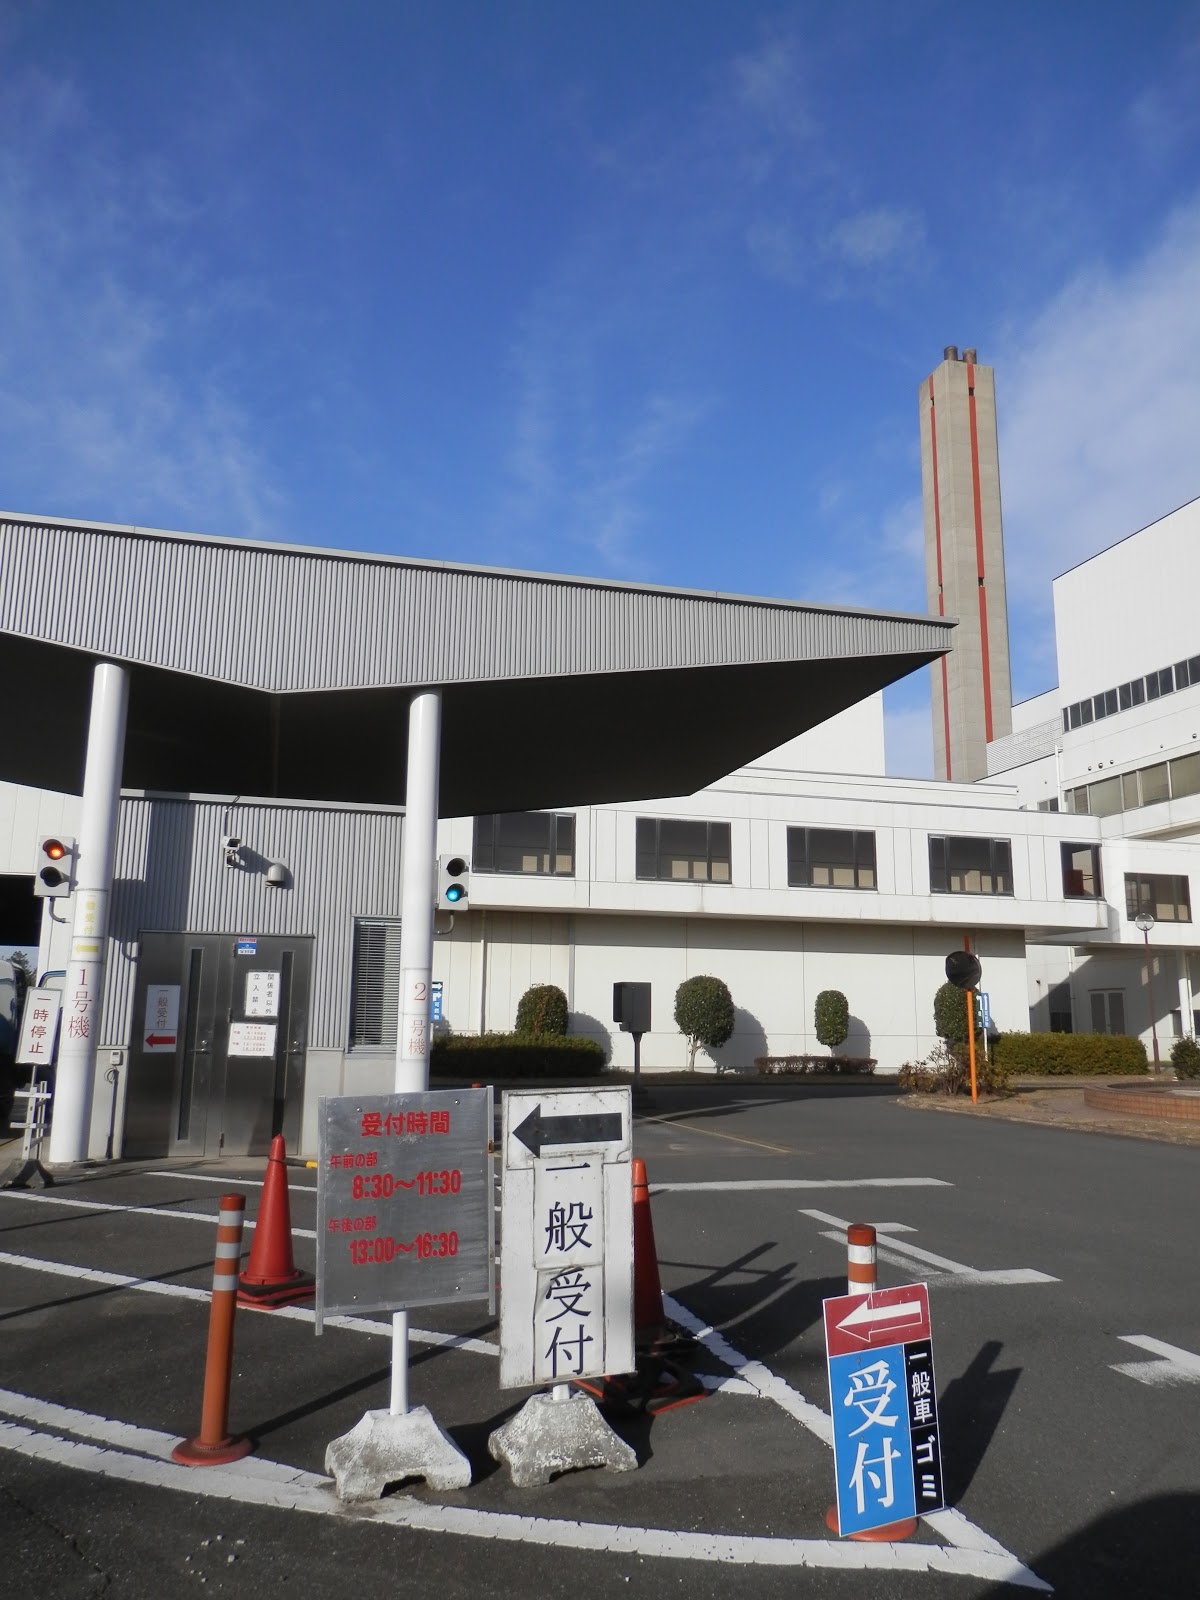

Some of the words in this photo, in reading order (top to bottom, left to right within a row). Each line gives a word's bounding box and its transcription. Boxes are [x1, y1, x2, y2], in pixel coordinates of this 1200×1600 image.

[28, 997, 51, 1054] 一時停止
[68, 968, 93, 1039] 1号機
[156, 989, 169, 1029] 一般受付
[408, 982, 427, 1056] 2号機
[360, 1110, 450, 1137] 受付時間
[329, 1152, 378, 1169] 午前の部
[327, 1215, 377, 1233] 午後の部
[544, 1161, 594, 1379] 一般受付
[843, 1359, 902, 1515] 受付
